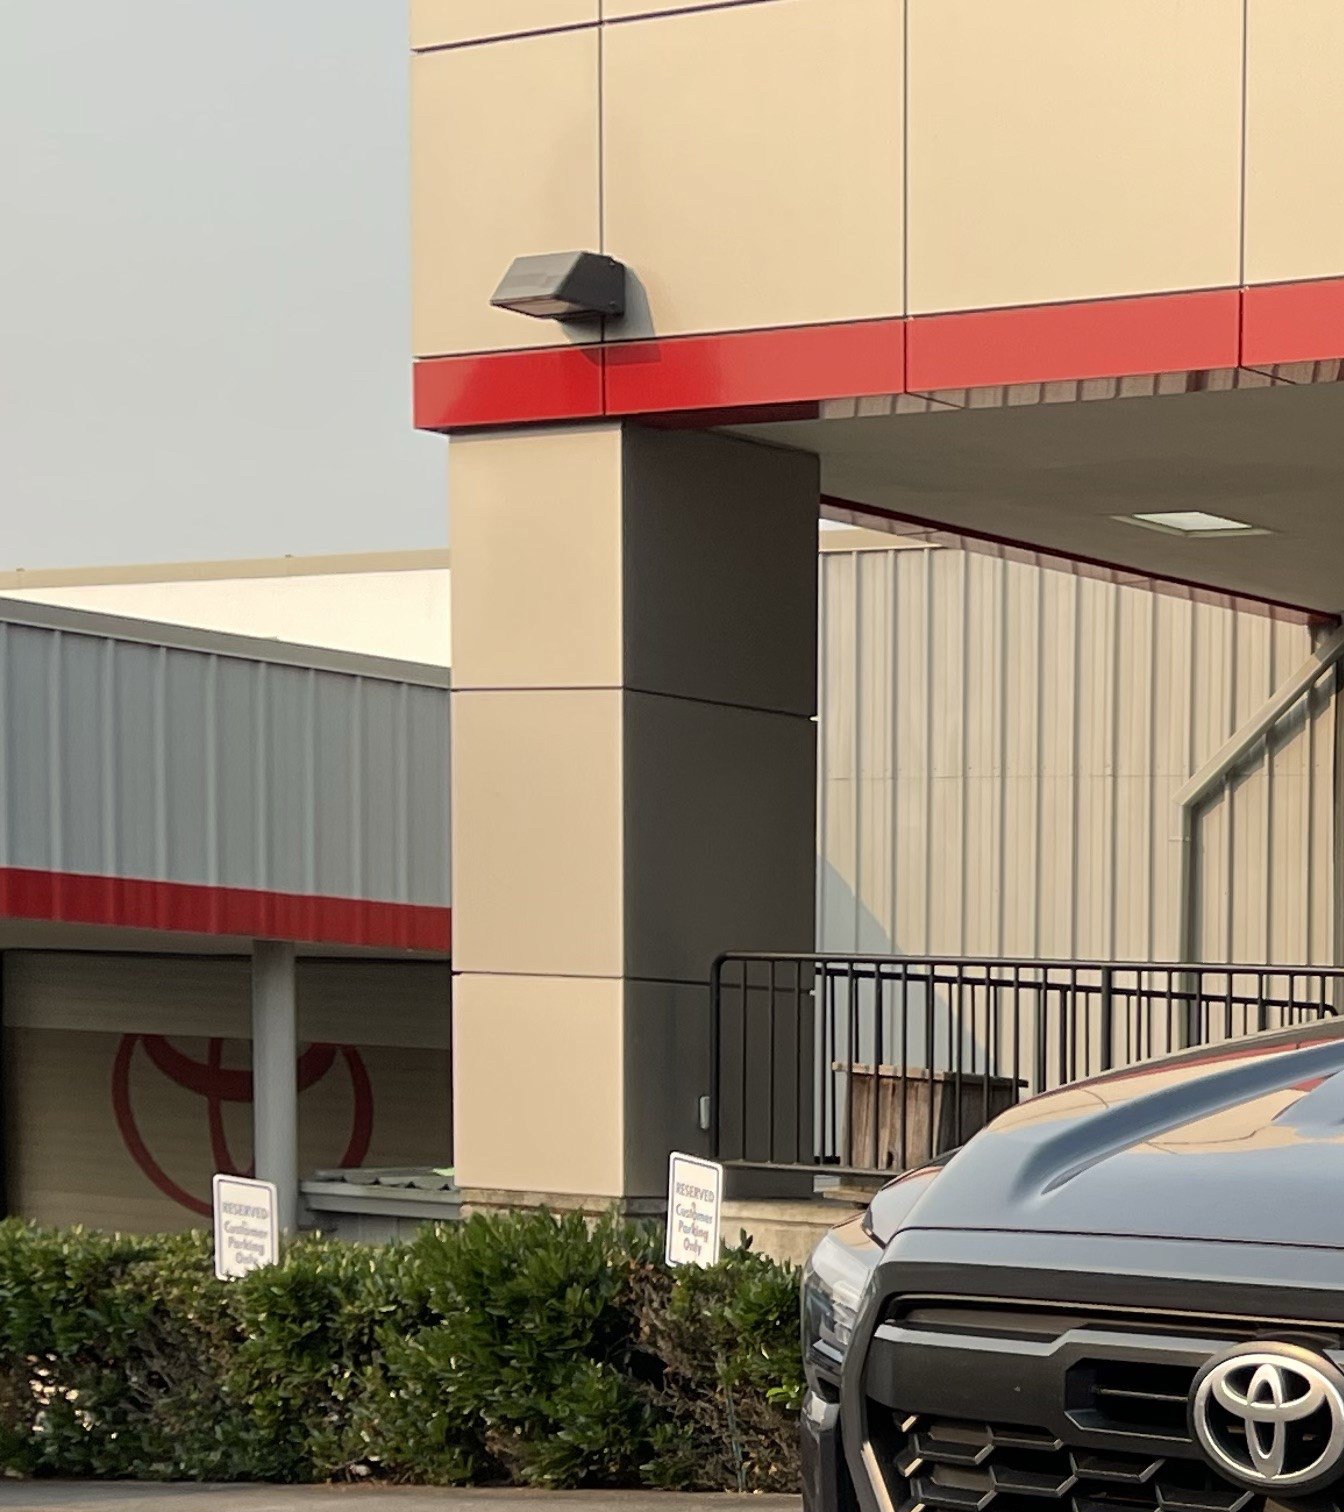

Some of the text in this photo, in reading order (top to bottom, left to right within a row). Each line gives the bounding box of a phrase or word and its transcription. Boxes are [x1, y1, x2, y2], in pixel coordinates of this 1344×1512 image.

[676, 1181, 715, 1203] RESERVED
[223, 1202, 268, 1220] RESERVED
[678, 1220, 709, 1243] Parking
[683, 1238, 702, 1256] Only
